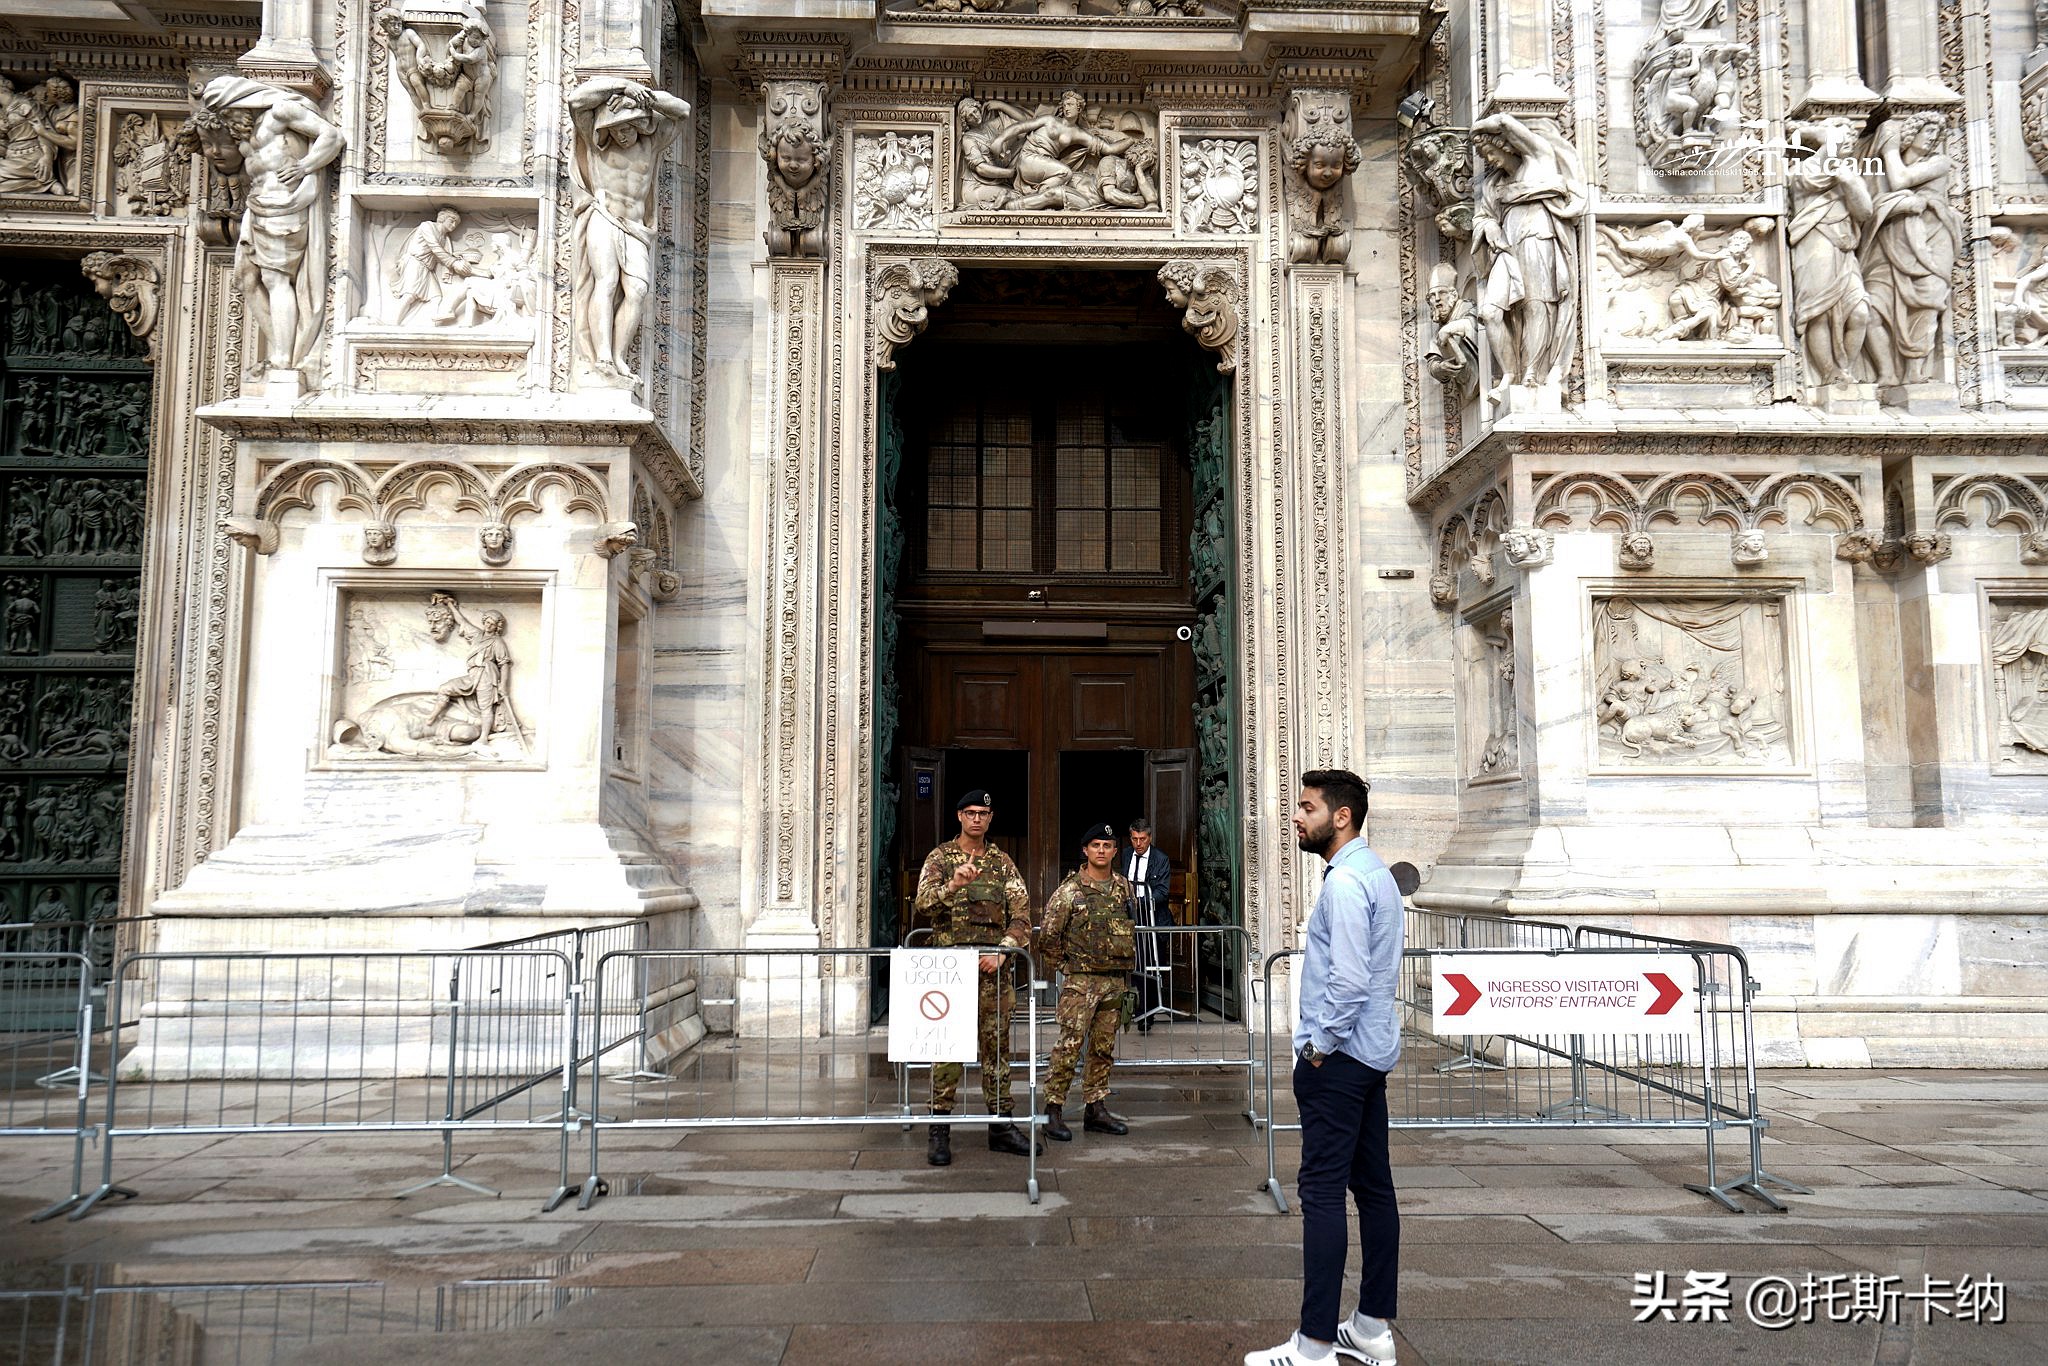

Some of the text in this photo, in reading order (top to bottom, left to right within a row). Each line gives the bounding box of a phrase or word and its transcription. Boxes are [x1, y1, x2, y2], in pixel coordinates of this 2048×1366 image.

[920, 786, 929, 794] EXIT
[910, 955, 957, 969] SOLO
[904, 971, 963, 985] USCITA
[1488, 980, 1639, 993] INGRESSO VISITATORI
[1560, 995, 1636, 1008] ENTRANCE
